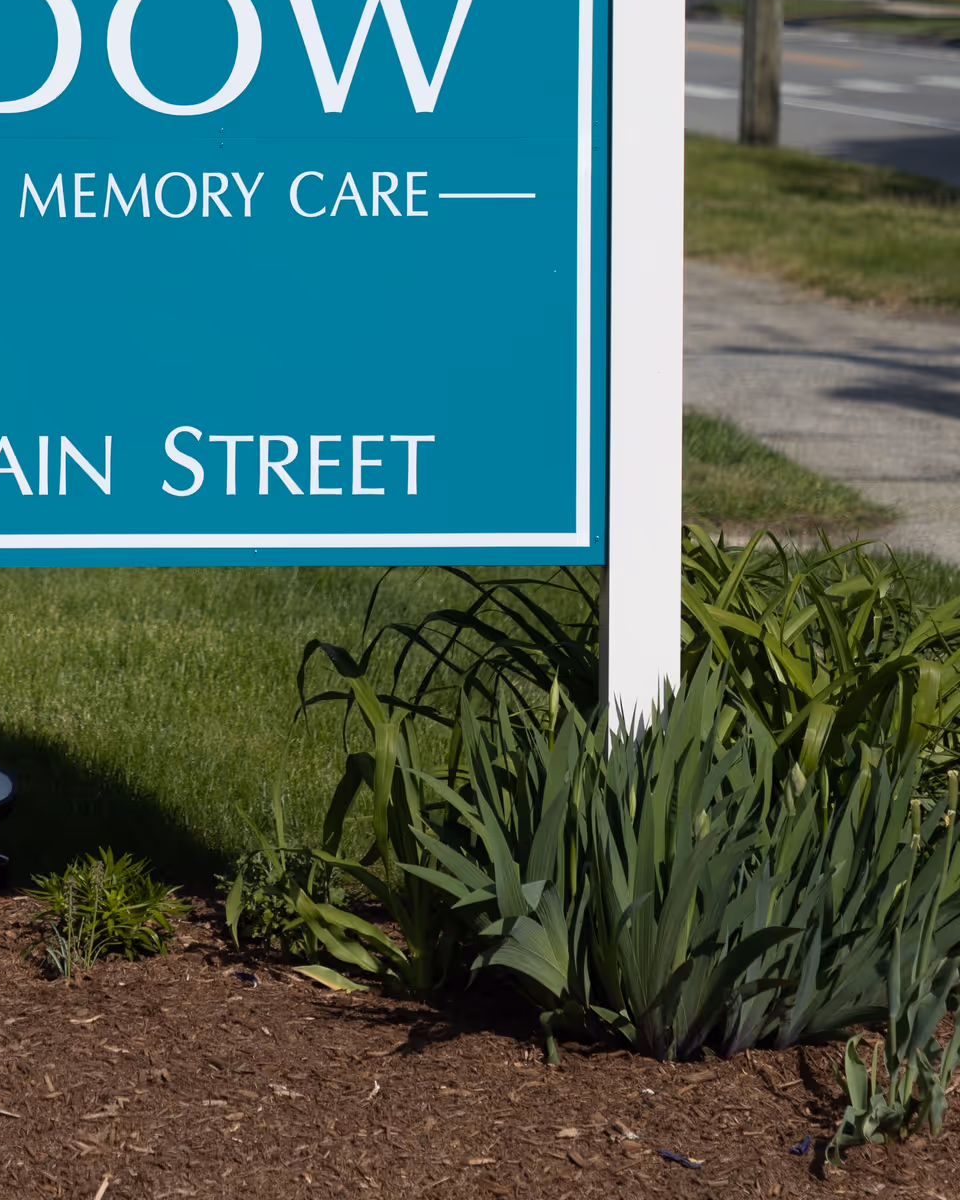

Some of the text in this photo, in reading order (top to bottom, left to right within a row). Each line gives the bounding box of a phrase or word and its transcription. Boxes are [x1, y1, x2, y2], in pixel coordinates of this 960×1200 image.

[19, 171, 265, 218] MEMORY
[289, 170, 429, 218] CARE
[161, 425, 436, 498] STREET
